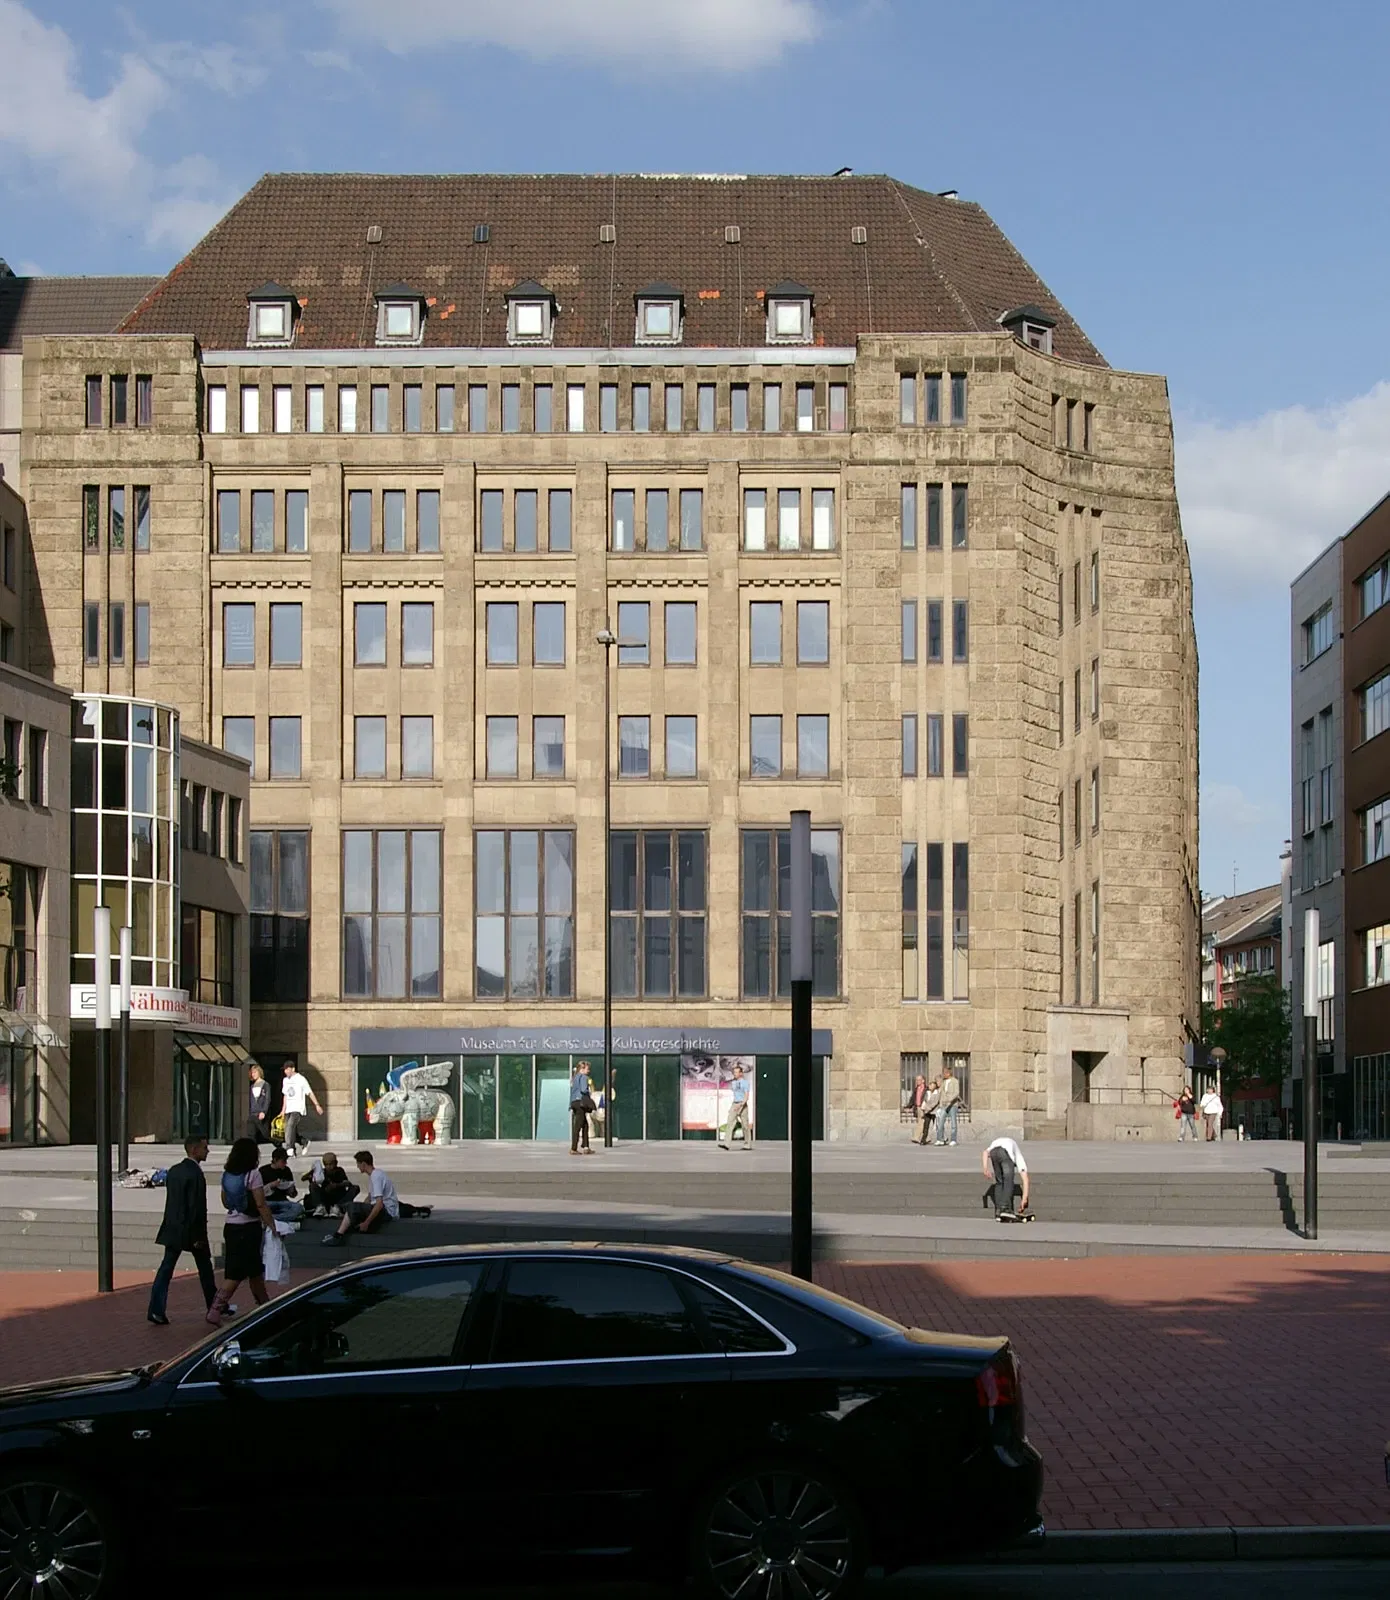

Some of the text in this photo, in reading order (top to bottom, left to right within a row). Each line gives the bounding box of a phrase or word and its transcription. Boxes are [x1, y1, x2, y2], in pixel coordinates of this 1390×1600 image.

[190, 1007, 239, 1030] Blättermann
[460, 1035, 517, 1050] Museum
[518, 1035, 538, 1050] für
[543, 1036, 581, 1050] Kunst
[612, 1035, 720, 1053] Kulturgeschichte
